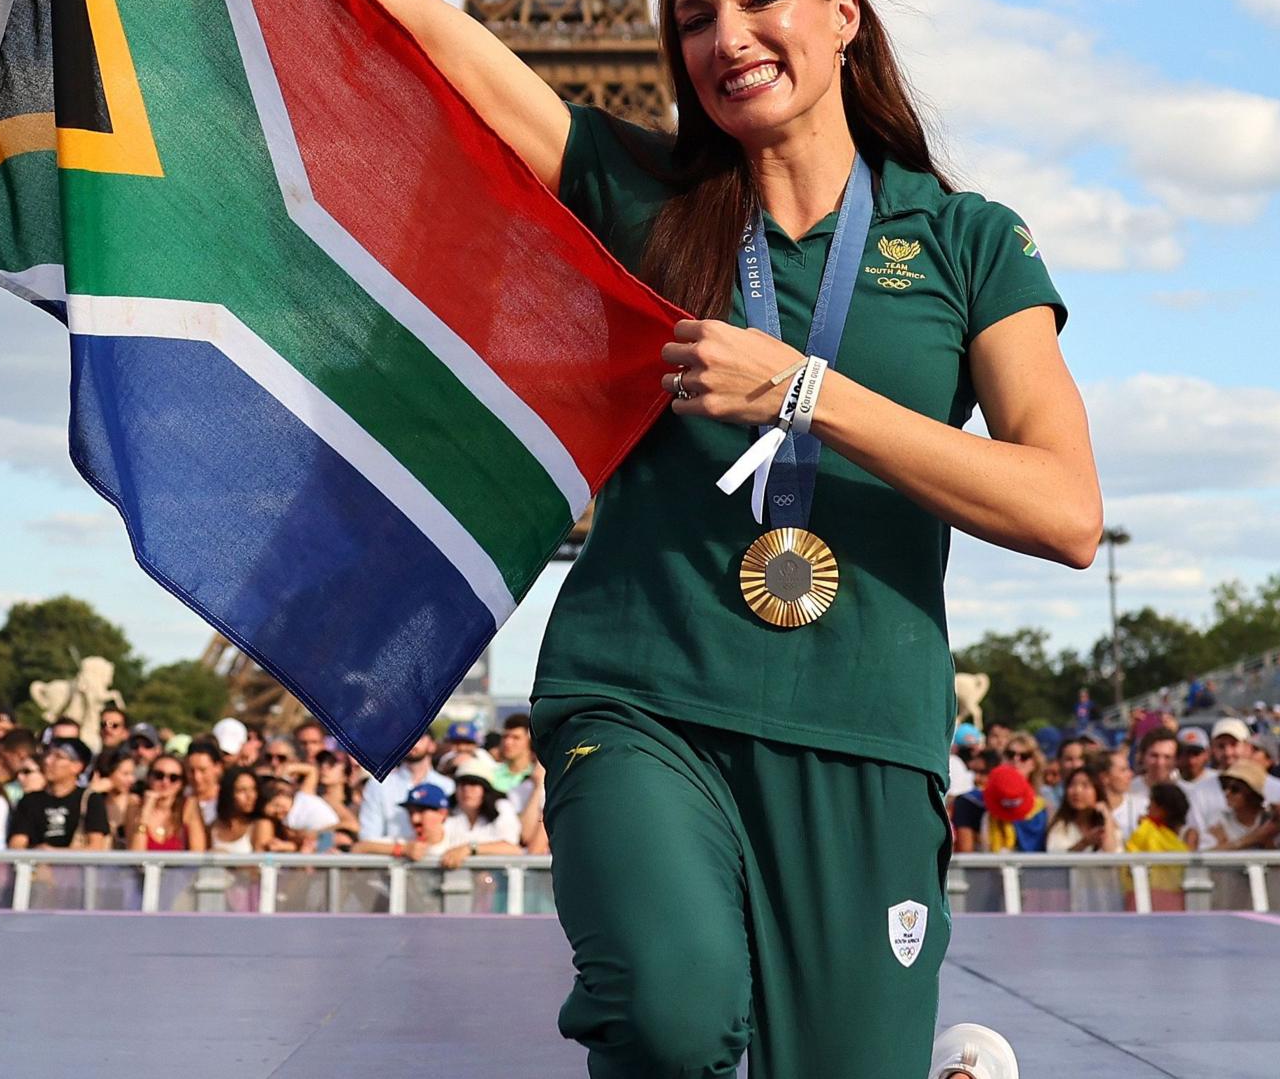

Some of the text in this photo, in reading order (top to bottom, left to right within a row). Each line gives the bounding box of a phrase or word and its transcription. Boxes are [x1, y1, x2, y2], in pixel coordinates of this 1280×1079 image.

[864, 266, 926, 279] SOUTH AFRICA
[884, 262, 908, 271] TEAM
[800, 379, 816, 413] Corona
